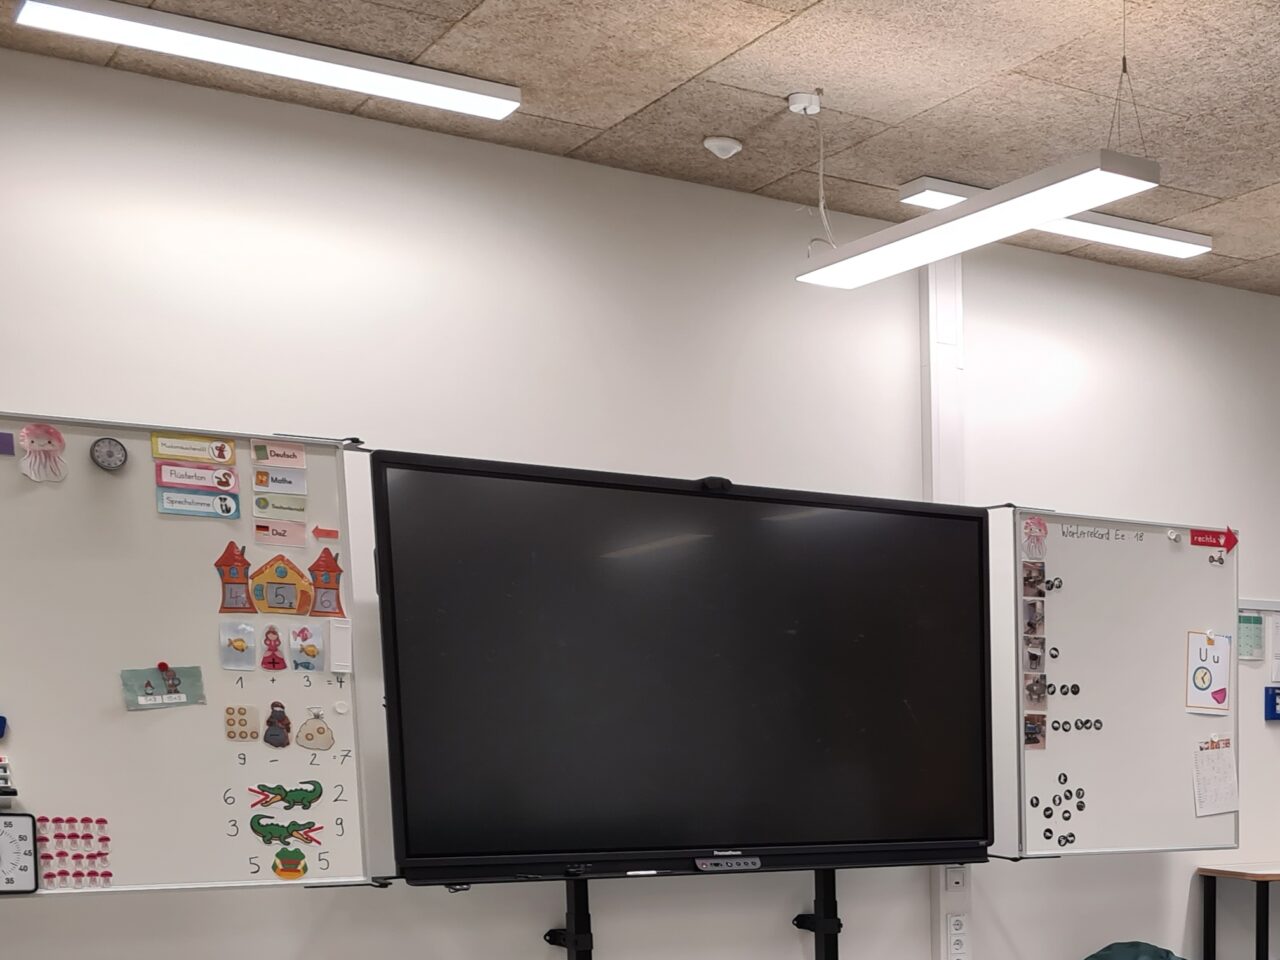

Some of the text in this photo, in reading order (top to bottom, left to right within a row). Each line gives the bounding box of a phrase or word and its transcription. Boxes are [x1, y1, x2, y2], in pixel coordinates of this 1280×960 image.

[269, 450, 298, 459] Deutsch
[169, 469, 207, 482] Flüsterton
[270, 476, 293, 485] Mathe
[271, 529, 288, 538] DaZ
[1193, 534, 1217, 544] rechts
[274, 586, 286, 605] 5
[320, 590, 332, 609] 6
[1199, 647, 1208, 662] U
[235, 676, 244, 689] 1
[303, 675, 312, 688] 3
[336, 675, 345, 689] 4
[237, 753, 247, 765] 9
[309, 753, 320, 766] 2
[340, 749, 352, 765] 7
[223, 785, 348, 805] 6 2
[226, 817, 345, 837] 3 9
[18, 834, 28, 842] 50
[249, 851, 330, 874] 5 5
[5, 877, 15, 885] 35
